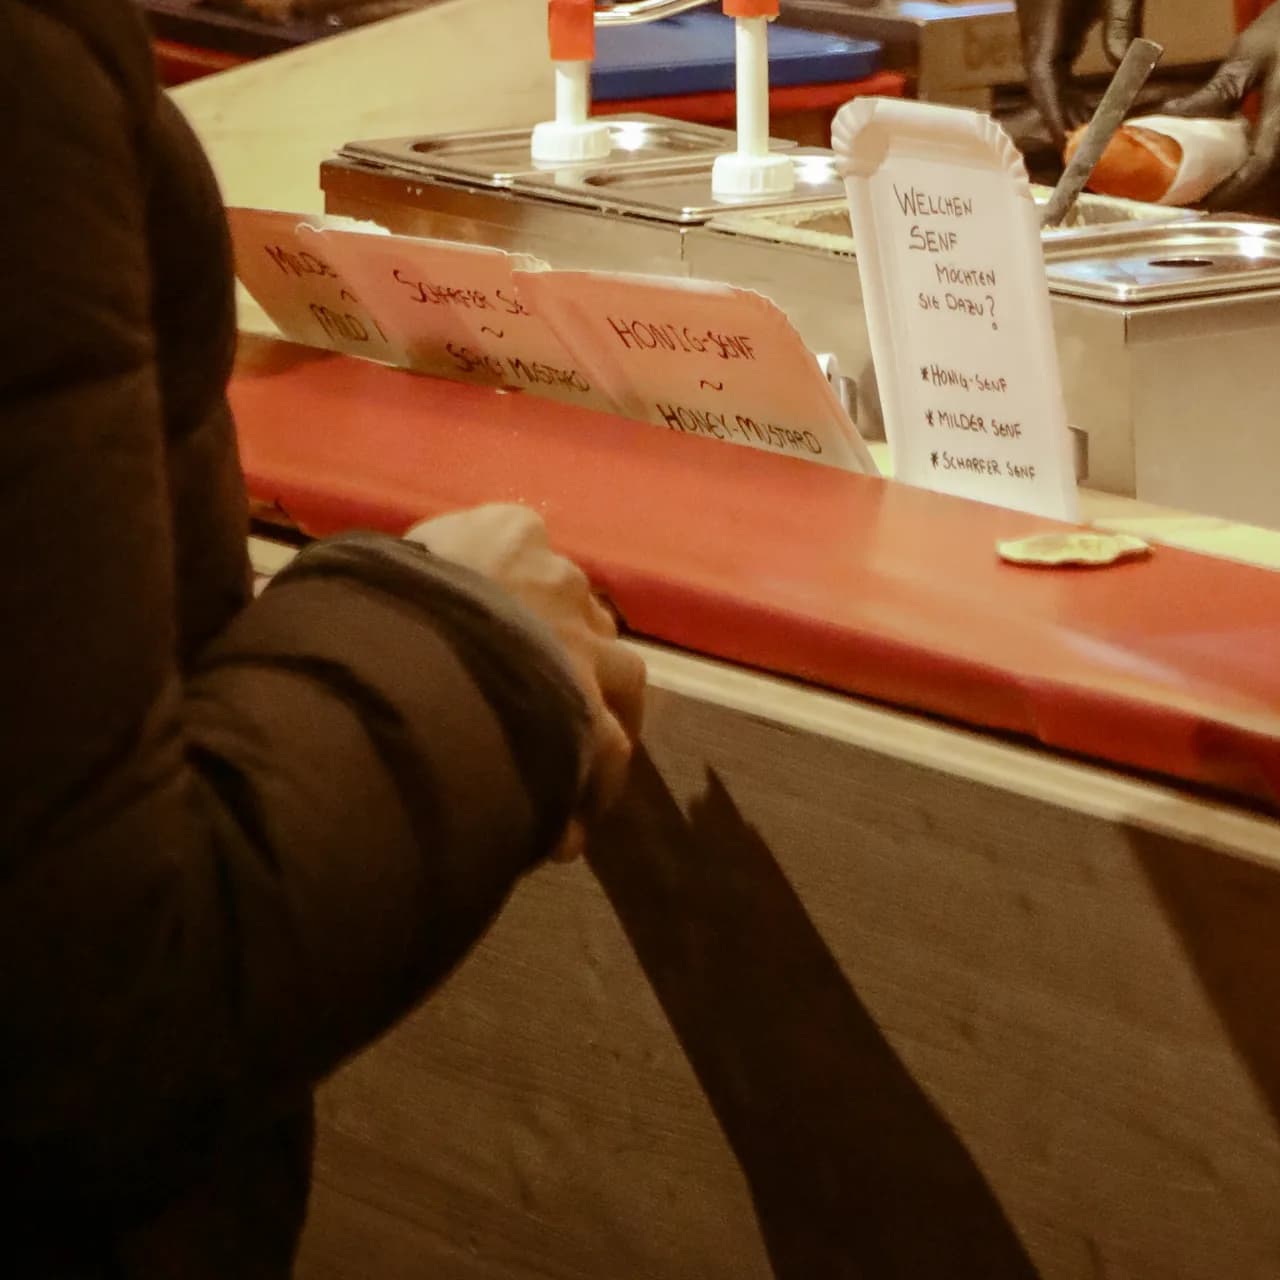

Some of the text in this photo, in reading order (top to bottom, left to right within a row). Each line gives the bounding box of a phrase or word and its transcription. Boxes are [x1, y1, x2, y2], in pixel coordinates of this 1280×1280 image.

[893, 184, 973, 216] WELCHEN
[909, 225, 958, 252] SENF
[495, 290, 530, 316] SE
[919, 292, 940, 310] SIE
[606, 316, 756, 360] HONIG-SENF
[656, 403, 823, 455] HONEY-MUSTARD
[937, 409, 1022, 439] MILDER SENF
